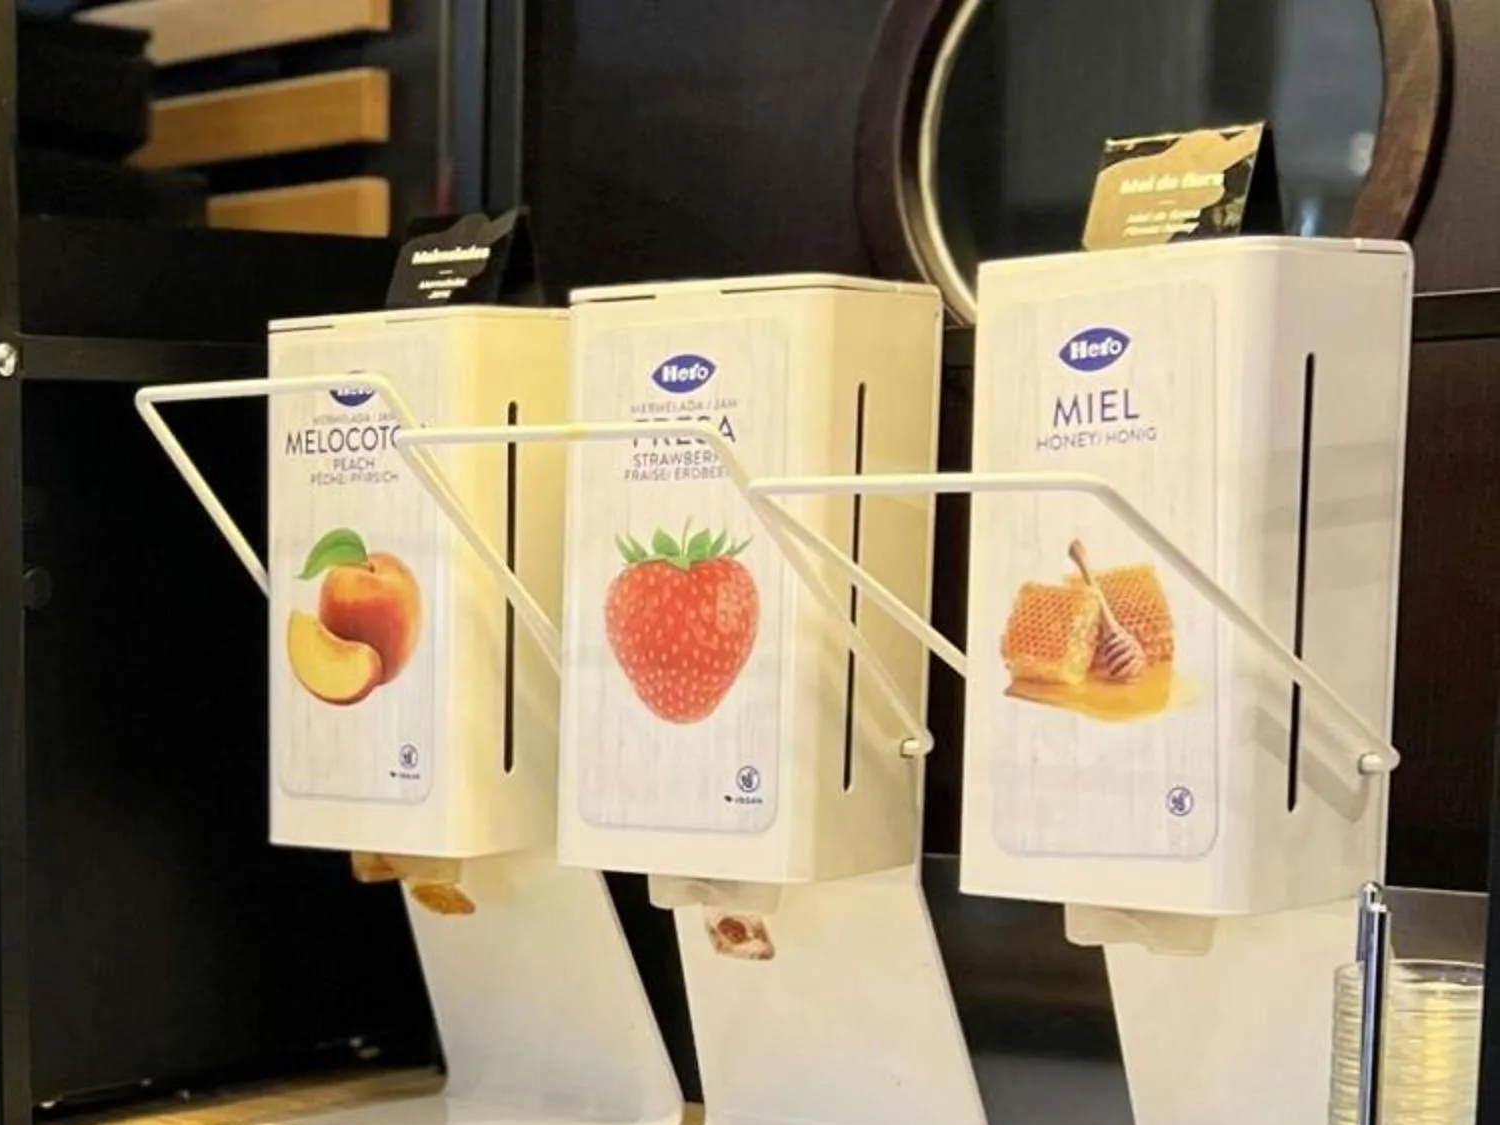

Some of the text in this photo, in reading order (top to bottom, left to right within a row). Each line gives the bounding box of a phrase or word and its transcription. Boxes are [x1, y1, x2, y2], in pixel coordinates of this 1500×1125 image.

[1069, 337, 1122, 361] Hero
[662, 363, 709, 383] Hero
[1052, 387, 1141, 428] MIEL
[285, 424, 404, 456] MELOCOTO
[1106, 425, 1157, 445] HONIG
[333, 457, 375, 471] PEACH
[632, 449, 719, 469] STRAWBERR
